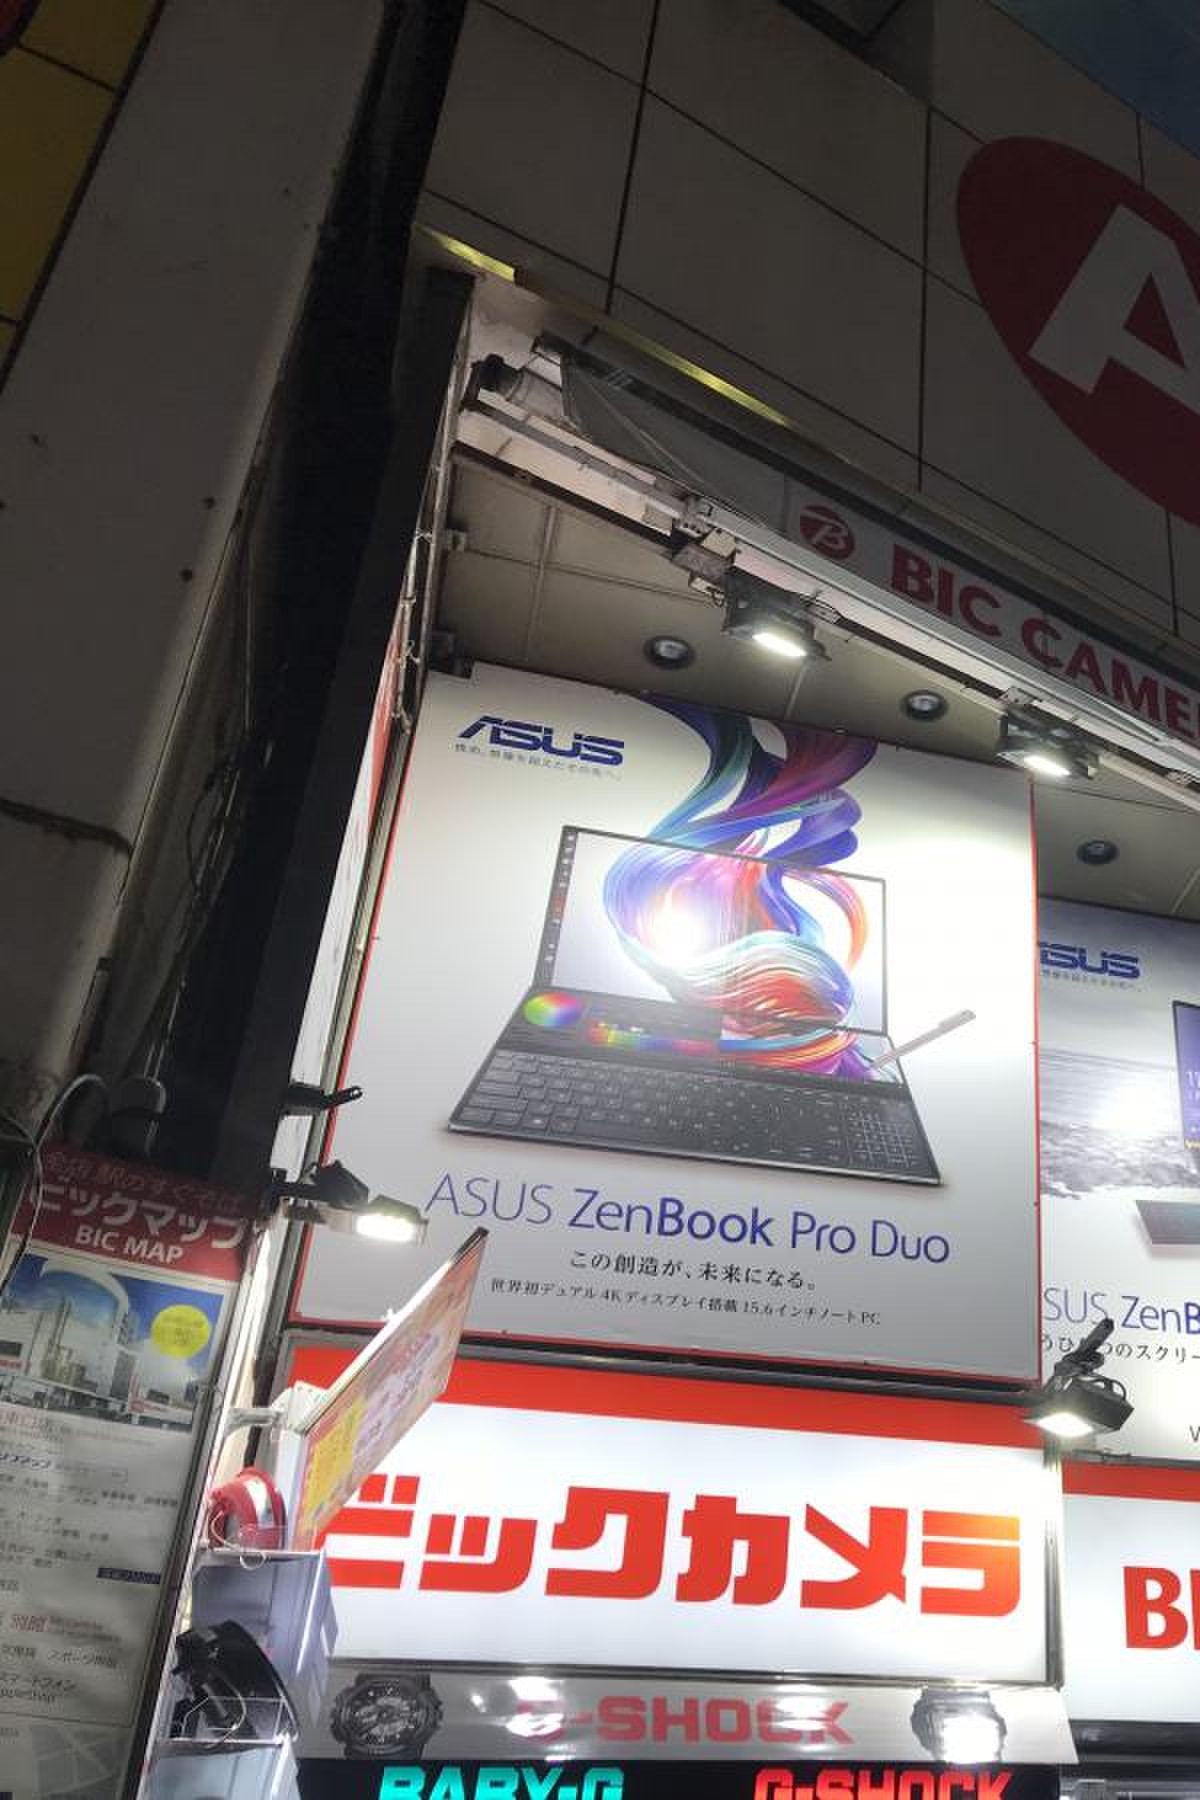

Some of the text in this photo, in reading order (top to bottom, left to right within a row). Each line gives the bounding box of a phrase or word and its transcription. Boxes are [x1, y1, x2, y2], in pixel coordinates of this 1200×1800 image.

[891, 543, 1002, 639] BIC
[457, 715, 625, 766] ASUS
[424, 1173, 951, 1264] ASUS ZenBook Pro Duo
[75, 1224, 184, 1264] BIC MAP
[570, 1250, 816, 1291] この創造が、未来になる。
[1043, 1287, 1110, 1326] SUS
[312, 1472, 1022, 1617] ビックカメラ
[379, 1766, 1012, 1800] BABY-G G-SHOCK
